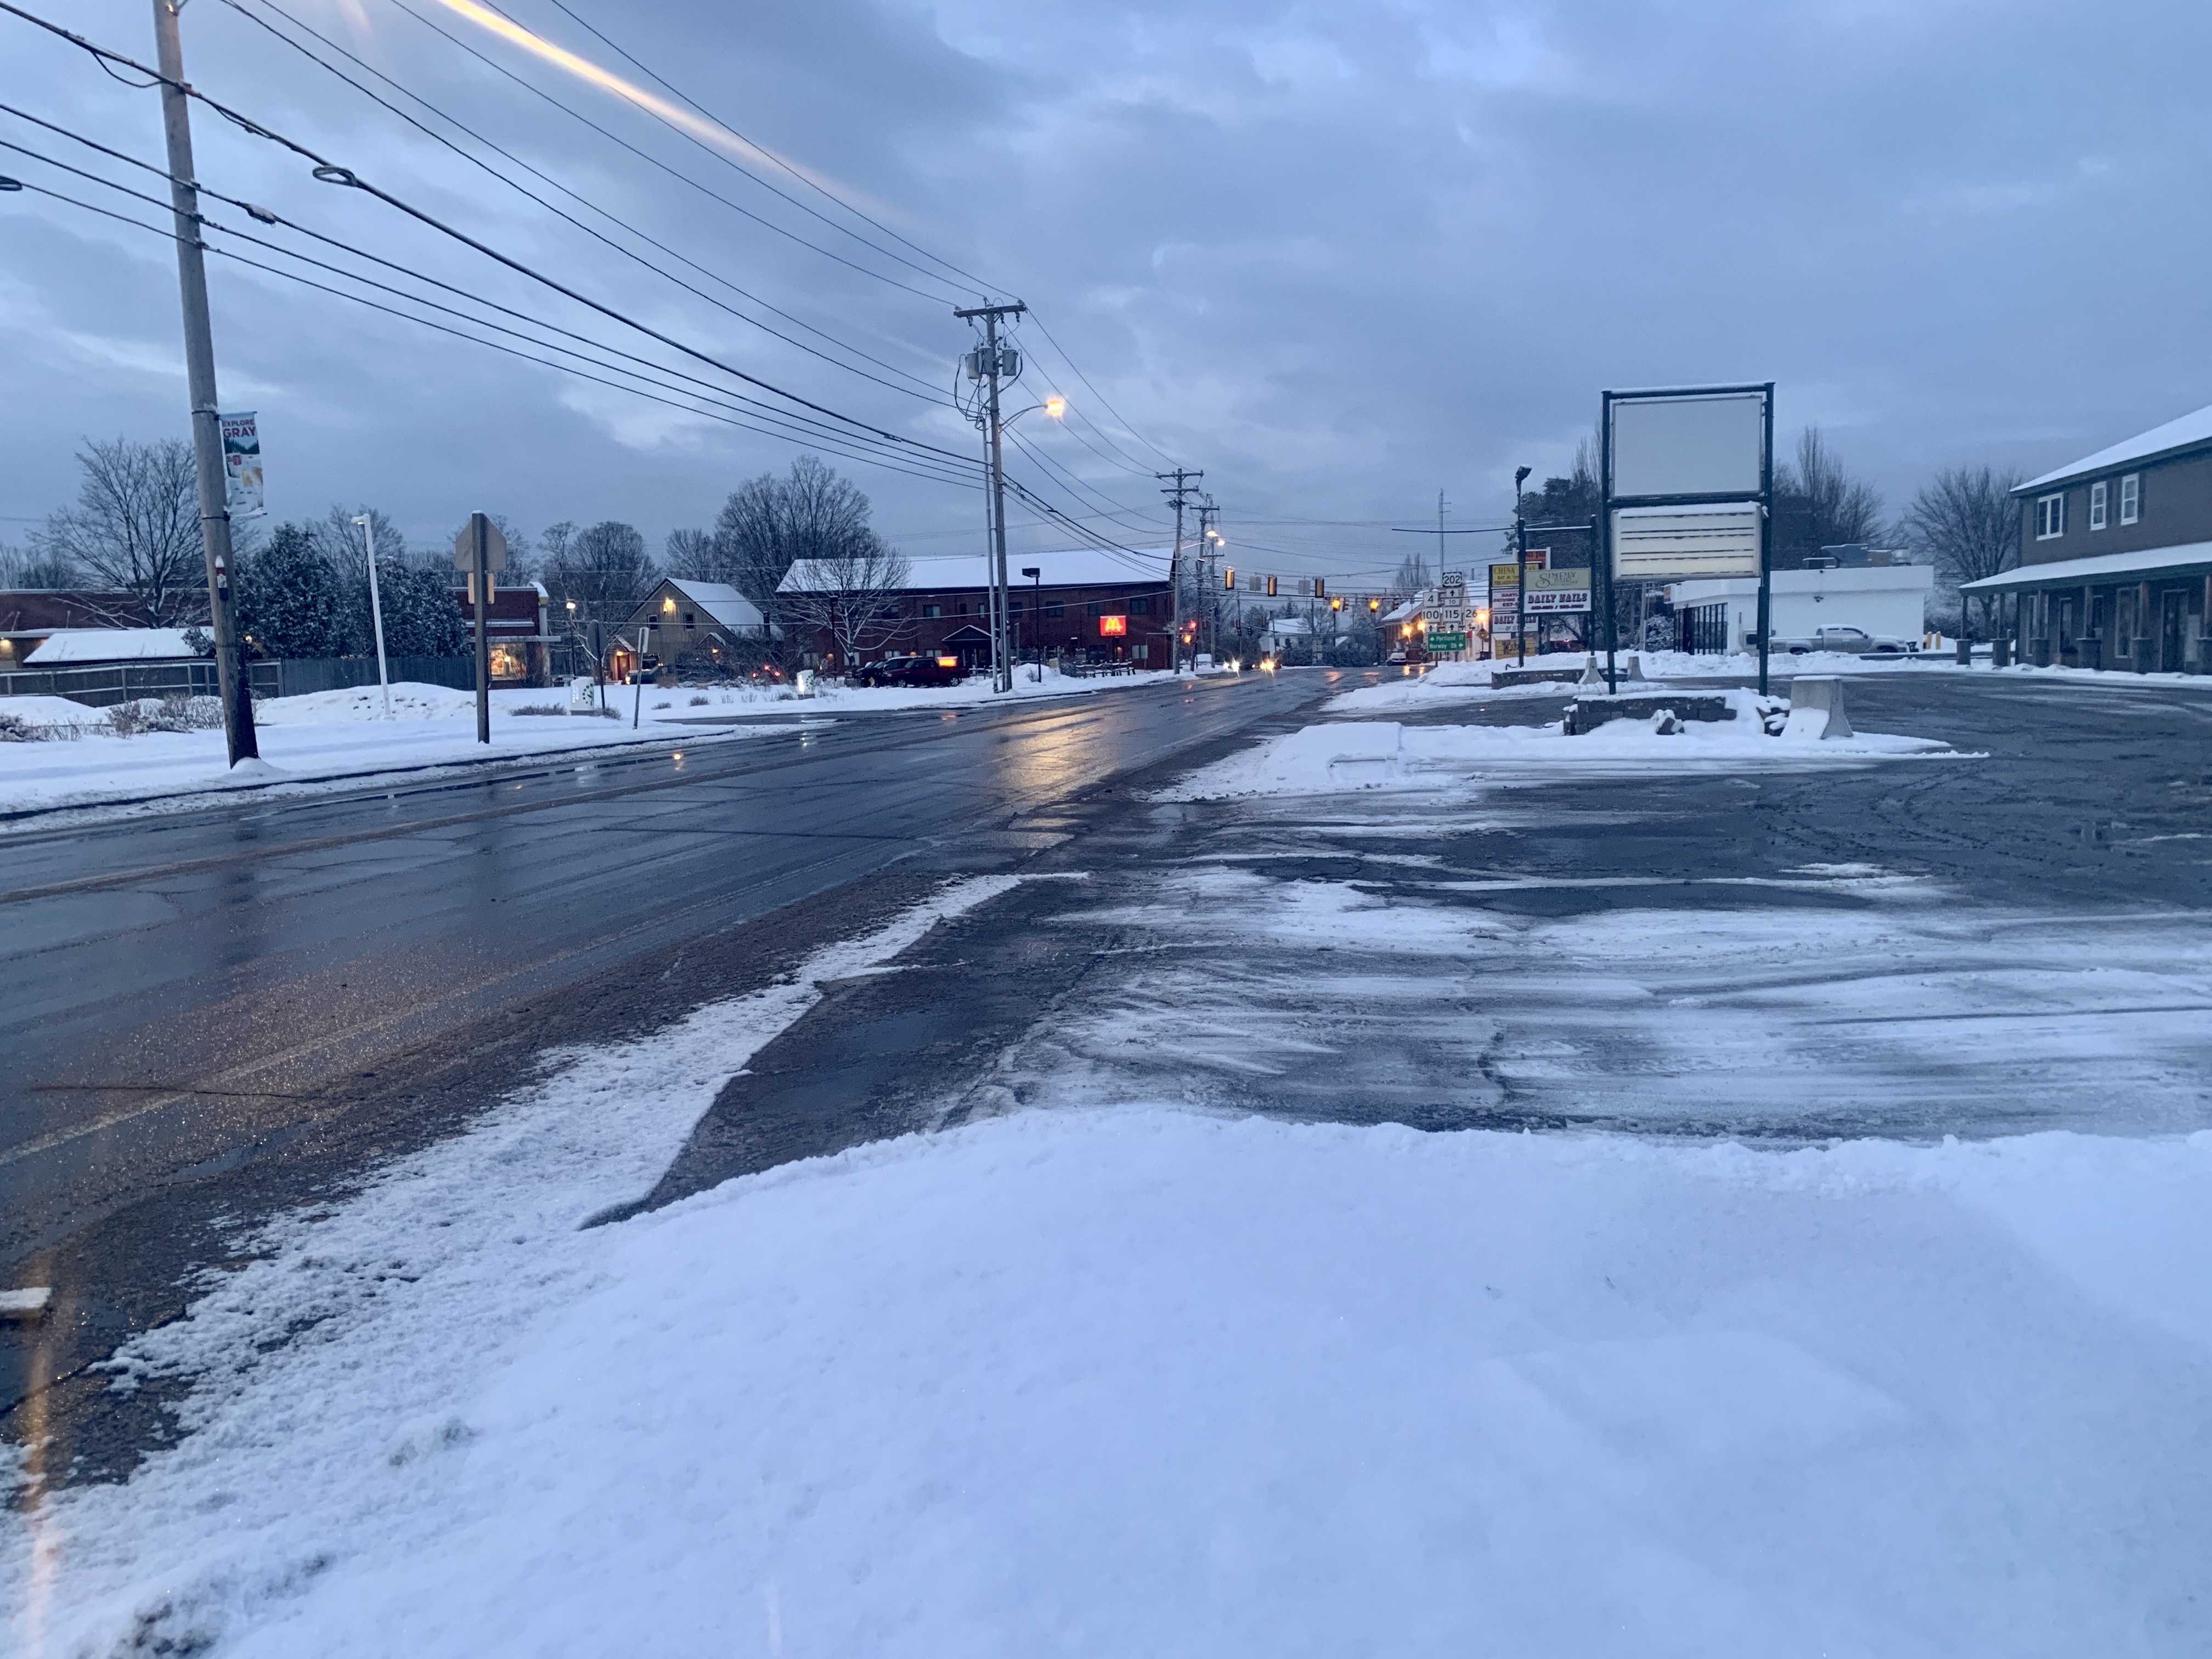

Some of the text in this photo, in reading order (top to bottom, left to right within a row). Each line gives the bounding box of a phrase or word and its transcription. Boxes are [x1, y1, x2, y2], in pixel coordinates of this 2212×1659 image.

[223, 426, 256, 437] GRAY
[1493, 566, 1515, 575] CHINA
[1443, 575, 1461, 584] 202
[1427, 595, 1434, 603] 4
[1528, 593, 1587, 603] DAILY NAILS
[1423, 611, 1439, 619] 100
[1445, 610, 1459, 618] 115
[1465, 610, 1477, 618] 26
[1494, 616, 1515, 624] DAILY
